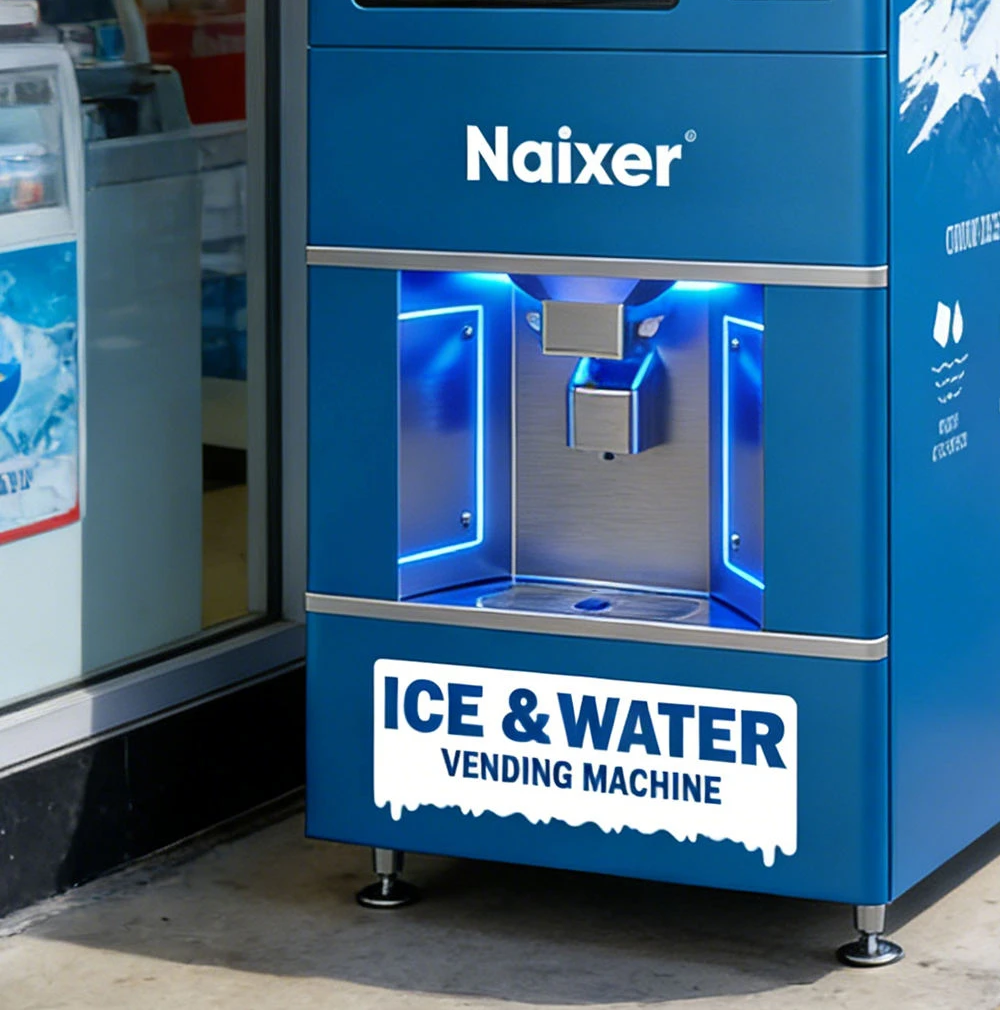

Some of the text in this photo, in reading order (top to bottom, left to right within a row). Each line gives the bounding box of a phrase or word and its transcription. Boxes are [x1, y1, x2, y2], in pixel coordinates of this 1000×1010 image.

[466, 124, 683, 187] Naixer
[383, 676, 788, 770] ICE & WATER
[440, 747, 722, 805] VENDING MACHINE
